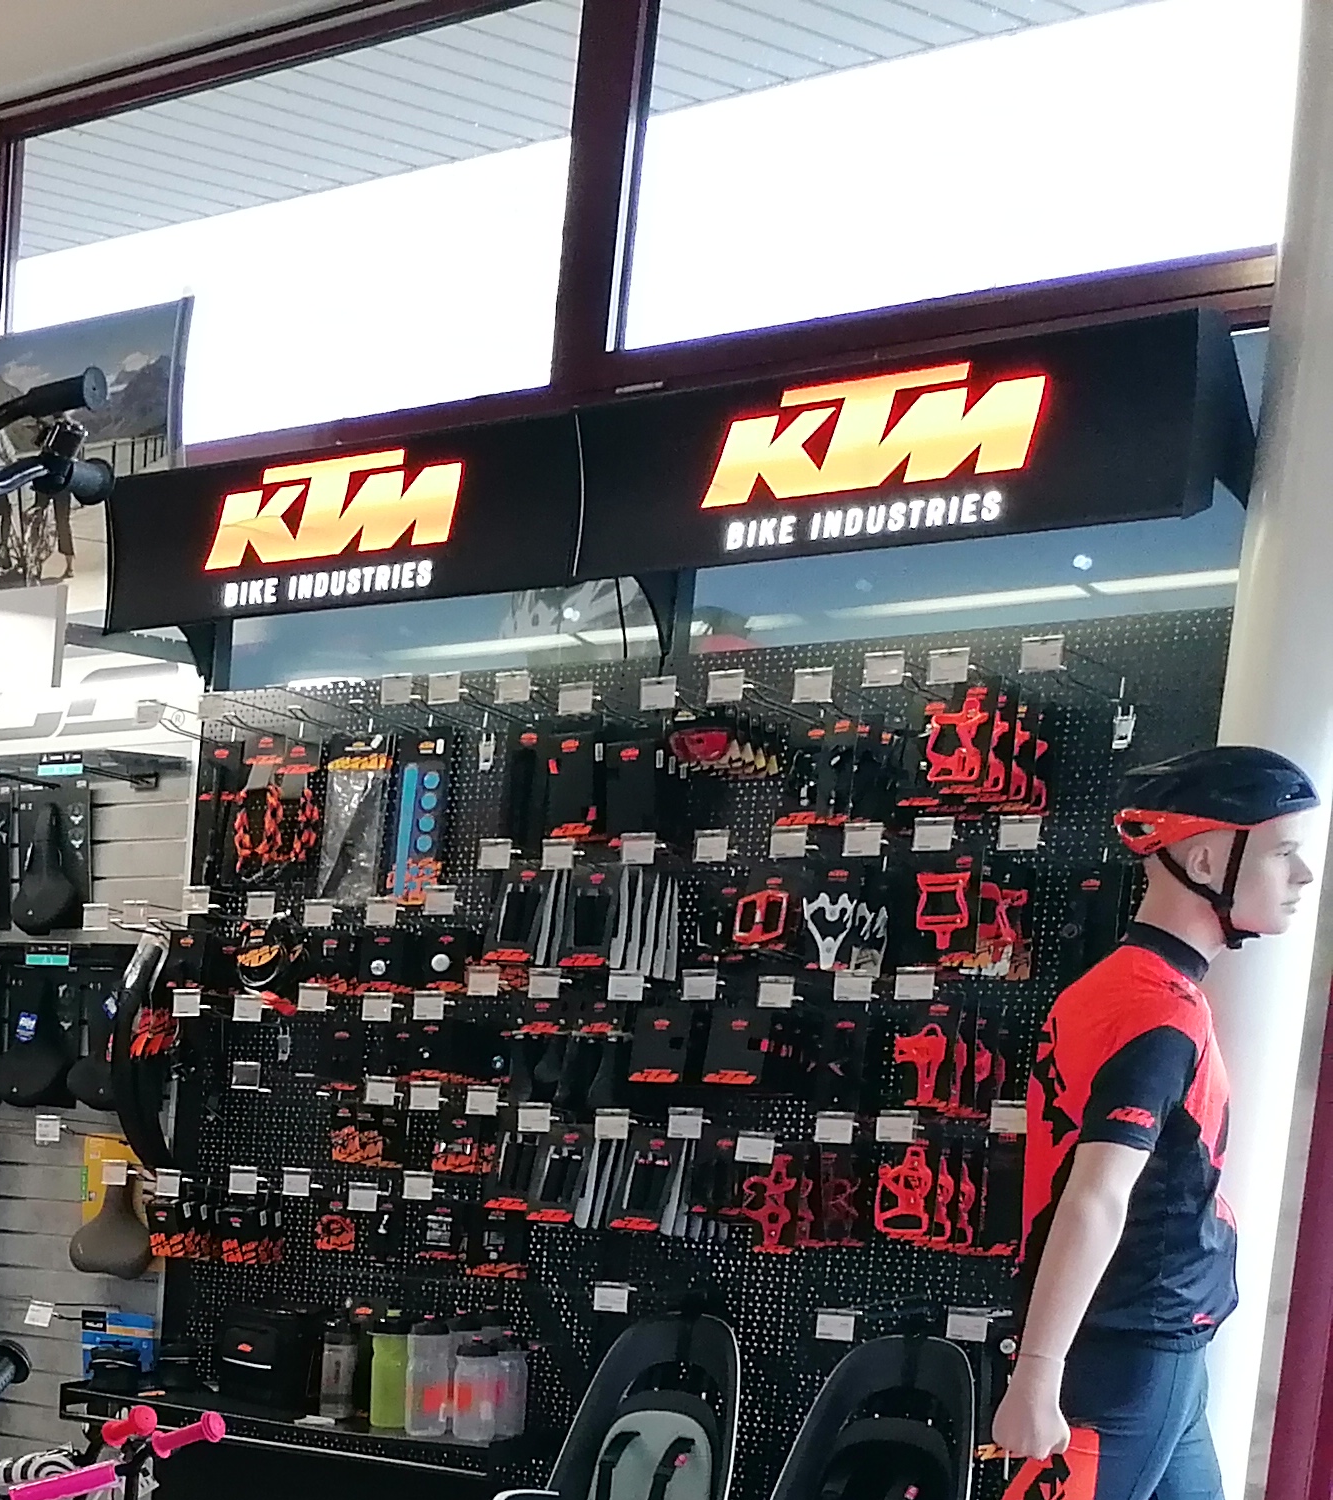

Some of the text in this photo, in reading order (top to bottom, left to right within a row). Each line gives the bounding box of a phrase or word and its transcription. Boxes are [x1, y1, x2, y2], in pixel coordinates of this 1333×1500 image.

[701, 362, 1044, 510] KTM
[204, 448, 464, 571] KTM
[725, 491, 1003, 551] BIKE INDUSTRIES
[222, 560, 434, 608] BIKE INDUSTRIES
